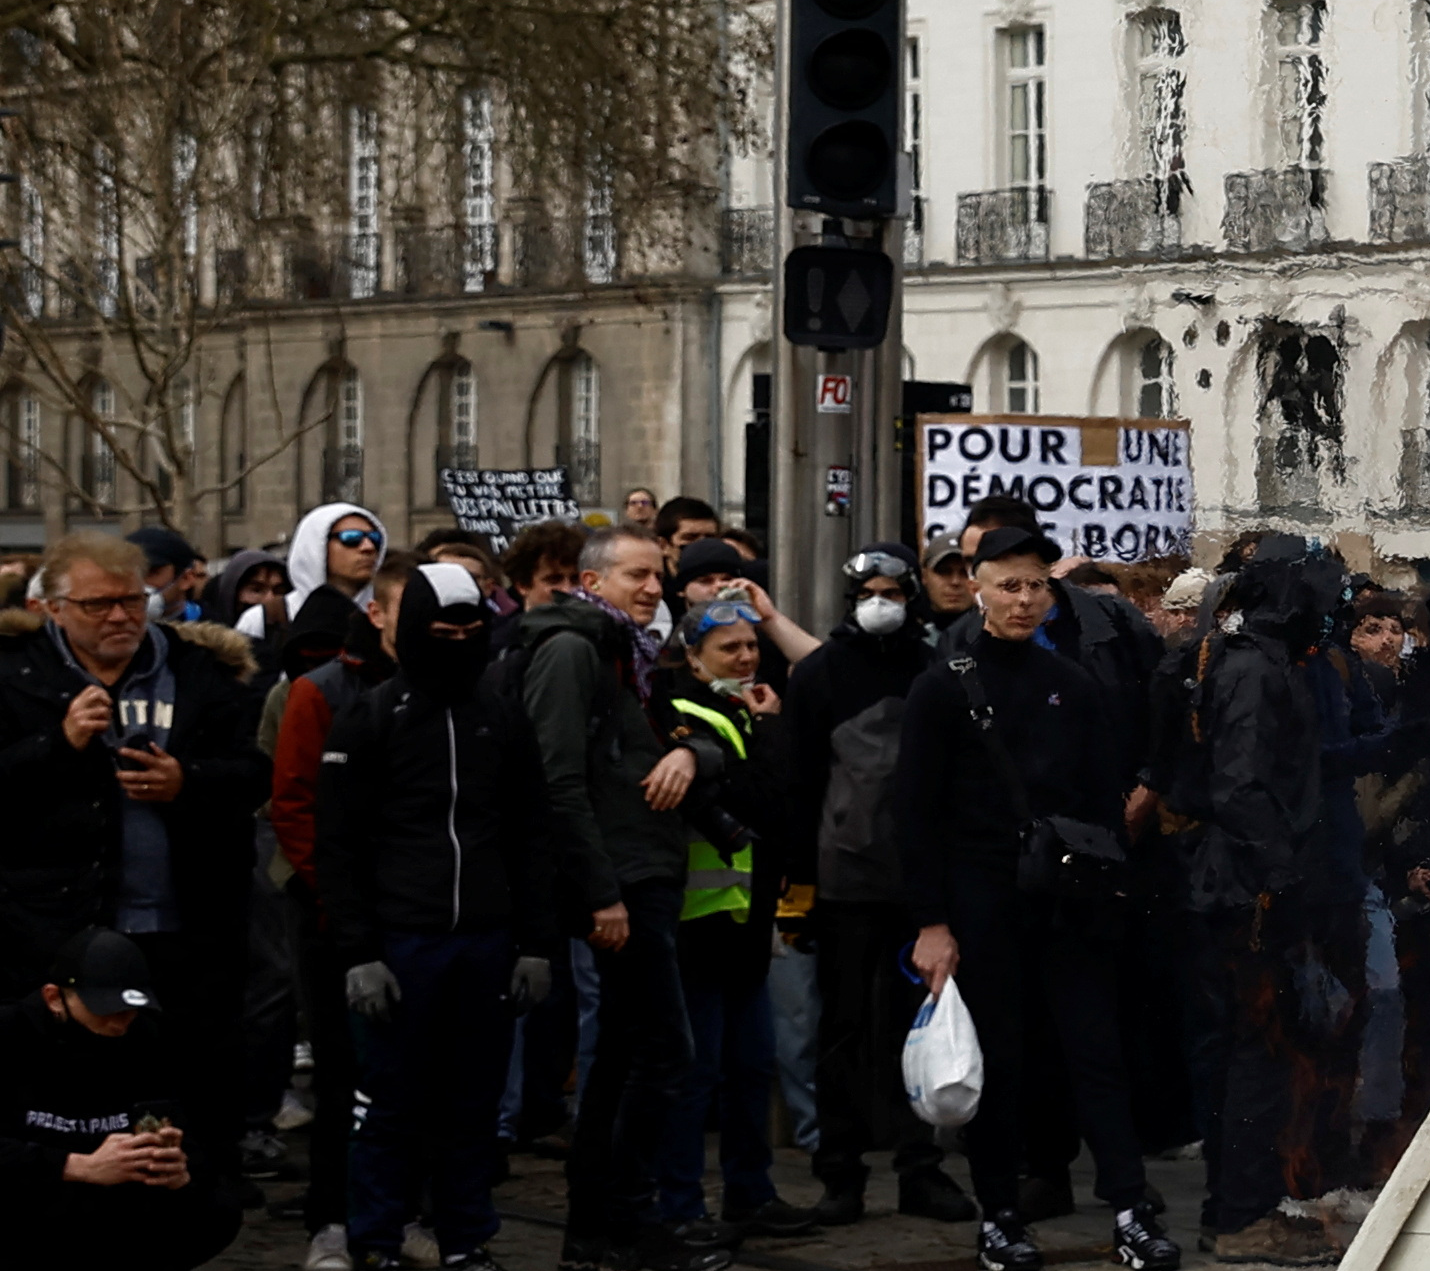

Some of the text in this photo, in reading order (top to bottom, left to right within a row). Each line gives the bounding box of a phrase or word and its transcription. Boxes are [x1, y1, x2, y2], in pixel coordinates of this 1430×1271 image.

[819, 377, 849, 405] FO
[928, 427, 1182, 467] POUR UNE
[443, 483, 467, 497] TU
[470, 485, 502, 499] VAS
[928, 466, 1186, 513] DÉMOCRATIE
[458, 517, 501, 535] DANS
[89, 1113, 130, 1134] PARIS
